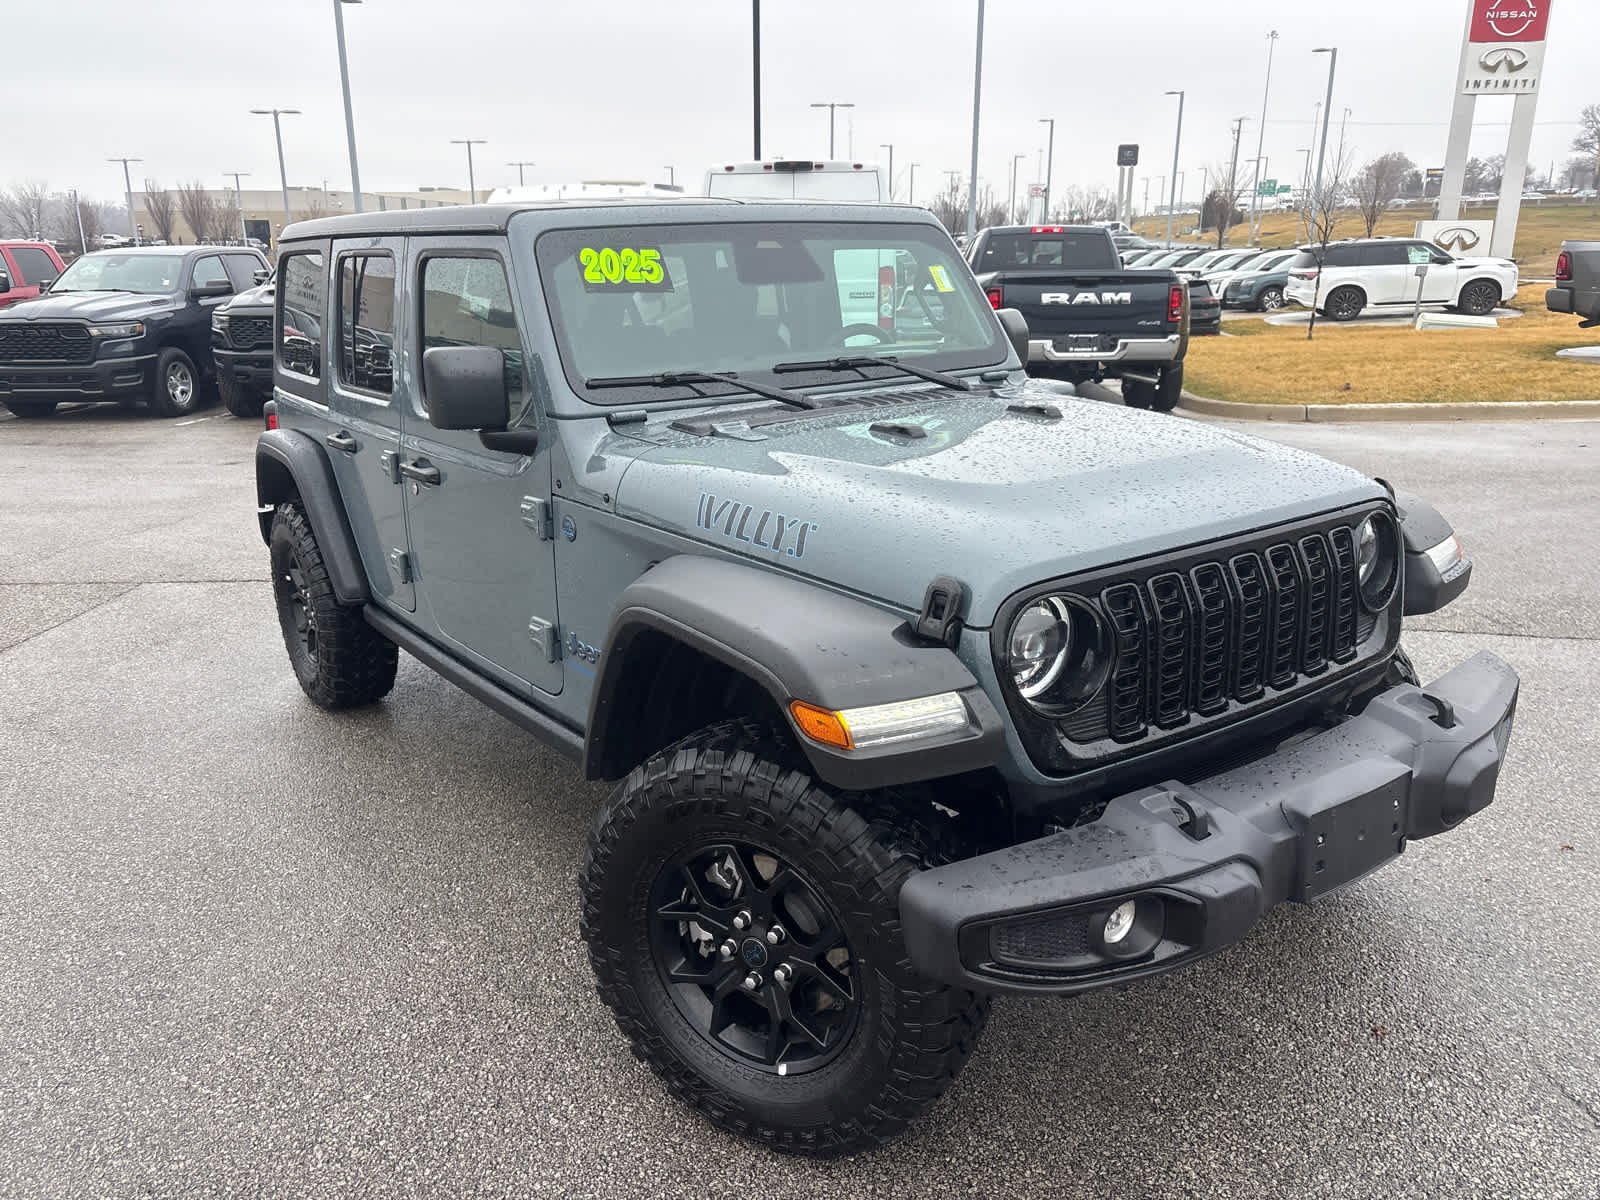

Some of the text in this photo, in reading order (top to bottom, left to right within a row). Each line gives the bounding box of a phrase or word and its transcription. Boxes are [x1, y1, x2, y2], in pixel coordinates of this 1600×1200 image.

[1486, 10, 1537, 18] NISSAN
[1465, 79, 1536, 88] INFINITI
[580, 247, 664, 284] 2025
[1041, 292, 1132, 304] RAM
[696, 492, 818, 558] WILLYS
